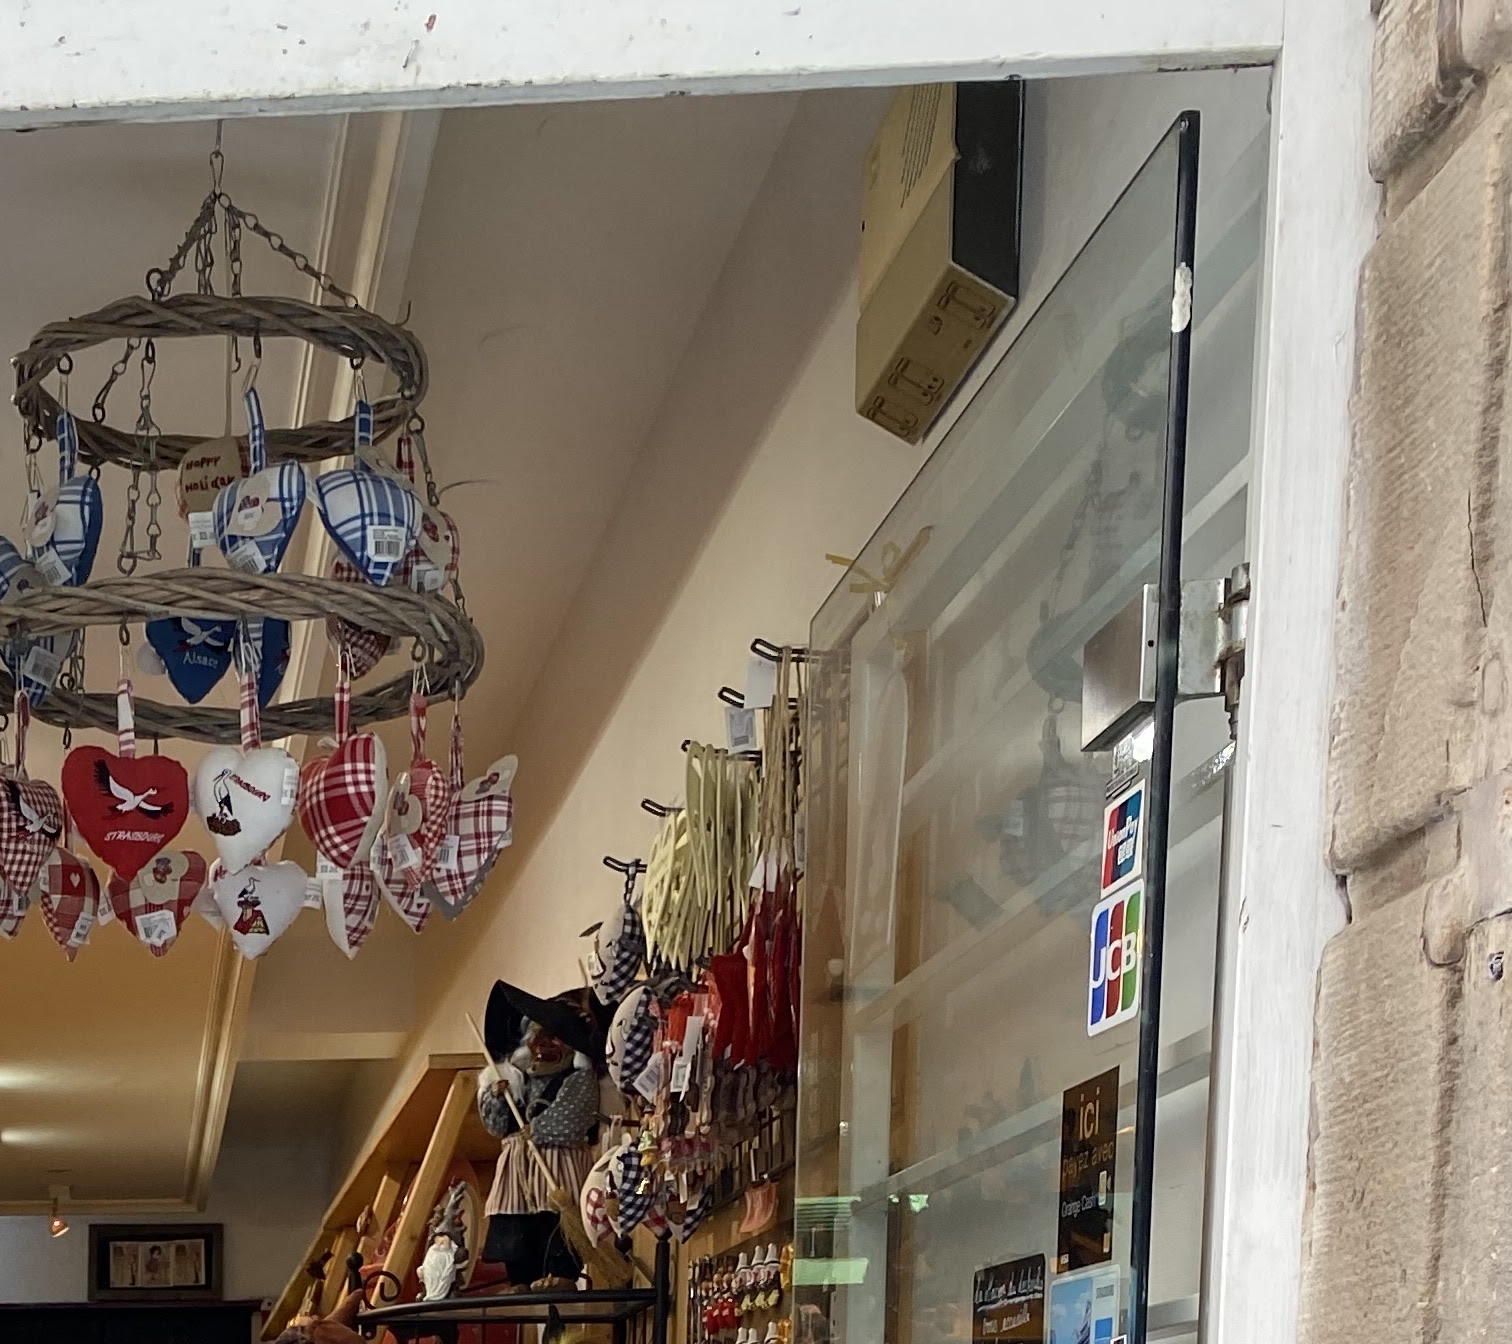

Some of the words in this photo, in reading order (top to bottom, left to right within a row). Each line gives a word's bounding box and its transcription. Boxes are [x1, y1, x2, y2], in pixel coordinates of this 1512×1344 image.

[183, 651, 219, 669] Alsace
[103, 829, 166, 845] STRASBOURG
[1090, 931, 1137, 989] JCB
[1078, 1086, 1101, 1142] ici
